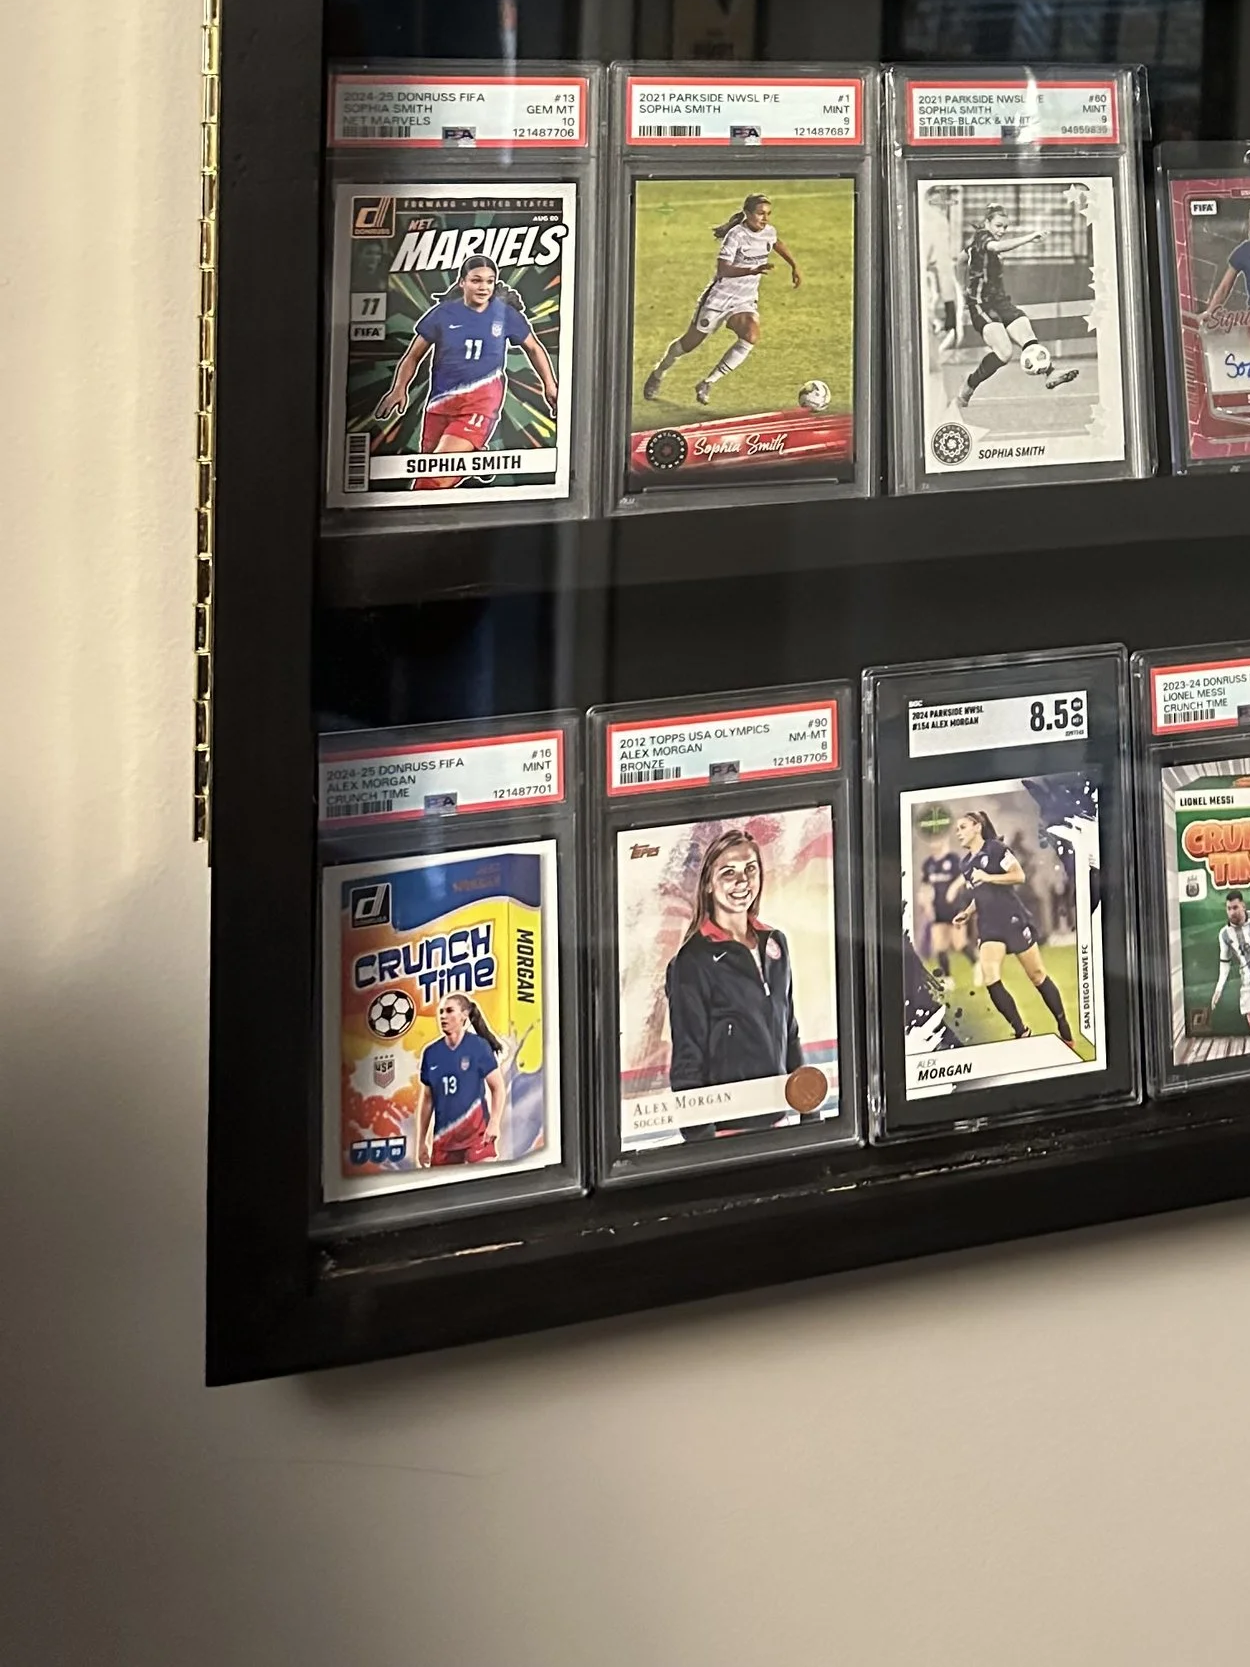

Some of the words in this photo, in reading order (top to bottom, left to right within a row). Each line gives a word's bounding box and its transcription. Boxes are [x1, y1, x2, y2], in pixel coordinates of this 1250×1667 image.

[344, 92, 394, 101] 2024-25
[397, 92, 456, 102] DONRUSS
[460, 93, 485, 102] FIFA
[639, 94, 667, 102] 2021
[670, 94, 723, 102] PARKSIDE
[727, 94, 760, 102] NWSL
[763, 94, 779, 103] P/E
[919, 95, 942, 103] 2021
[946, 95, 993, 103] PARKSIDE
[997, 95, 1025, 103] NWSL
[344, 105, 389, 113] SOPHIA
[394, 105, 432, 113] SMITH
[527, 106, 552, 114] GEM
[556, 106, 574, 114] MT
[639, 105, 681, 113] SOPHIA
[685, 105, 721, 113] SMITH
[823, 105, 850, 114] MINT
[919, 106, 956, 114] SOPHIA
[960, 106, 991, 114] SMITH
[343, 116, 366, 125] NET
[371, 116, 430, 126] MARVELS
[563, 118, 575, 126] 10
[1194, 204, 1213, 212] FIFA
[390, 224, 568, 272] MARVELS
[693, 438, 741, 461] Sophia
[746, 433, 787, 455] Smith
[978, 448, 1013, 459] SOPHIA
[1015, 446, 1045, 458] SMITH
[406, 456, 466, 473] SOPHIA
[472, 455, 521, 471] SMITH
[1163, 679, 1201, 691] 2023-24
[1203, 674, 1247, 686] DONRUSS
[1164, 691, 1195, 702] LIONEL
[1197, 688, 1226, 697] MESSI
[1164, 701, 1203, 713] CRUNCH
[1207, 698, 1227, 707] TIME
[1030, 699, 1068, 732] 8.5
[621, 738, 646, 748] 2012
[651, 733, 685, 745] TOPPS
[689, 731, 711, 741] USA
[715, 724, 770, 738] OLYMPICS
[621, 748, 649, 760] ALEX
[653, 743, 702, 756] MORGAN
[327, 767, 376, 781] 2024-25
[379, 762, 436, 775] DONRUSS
[439, 758, 464, 768] FIFA
[523, 761, 551, 772] MINT
[621, 759, 665, 772] BRONZE
[327, 781, 358, 793] ALEX
[362, 775, 416, 789] MORGAN
[327, 793, 378, 805] CRUNCH
[382, 788, 409, 800] TIME
[1180, 796, 1208, 807] LIONEL
[1209, 795, 1234, 805] MESSI
[516, 929, 535, 1004] MORGAN
[918, 1063, 972, 1081] MORGAN
[442, 1076, 457, 1095] 13
[634, 1101, 669, 1117] ALEX
[675, 1093, 732, 1110] MORGAN
